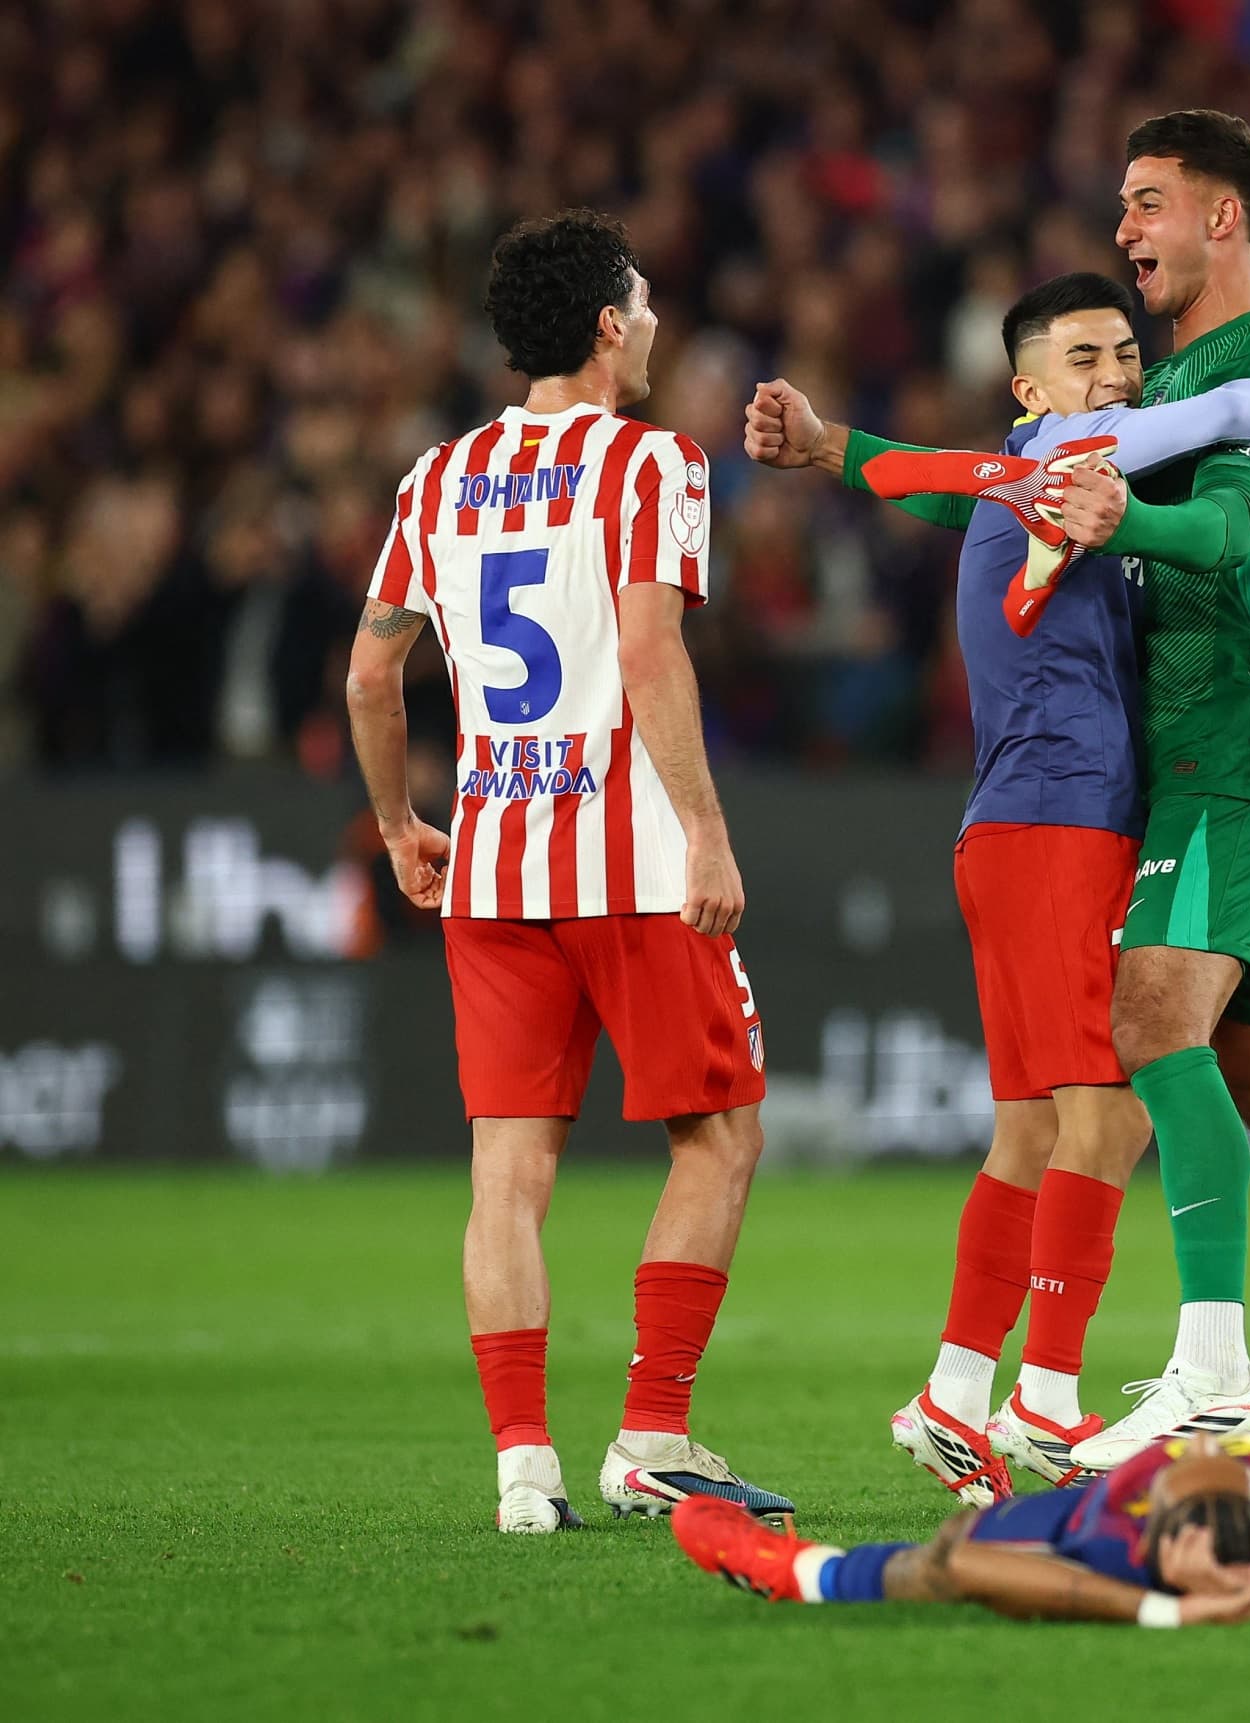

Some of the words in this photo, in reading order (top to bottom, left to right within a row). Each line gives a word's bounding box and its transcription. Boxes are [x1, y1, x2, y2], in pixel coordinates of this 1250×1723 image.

[480, 547, 563, 725] 5
[490, 740, 573, 769] VISIT
[460, 766, 597, 799] RWANDA
[1134, 858, 1177, 886] Ave
[729, 946, 756, 1018] 5
